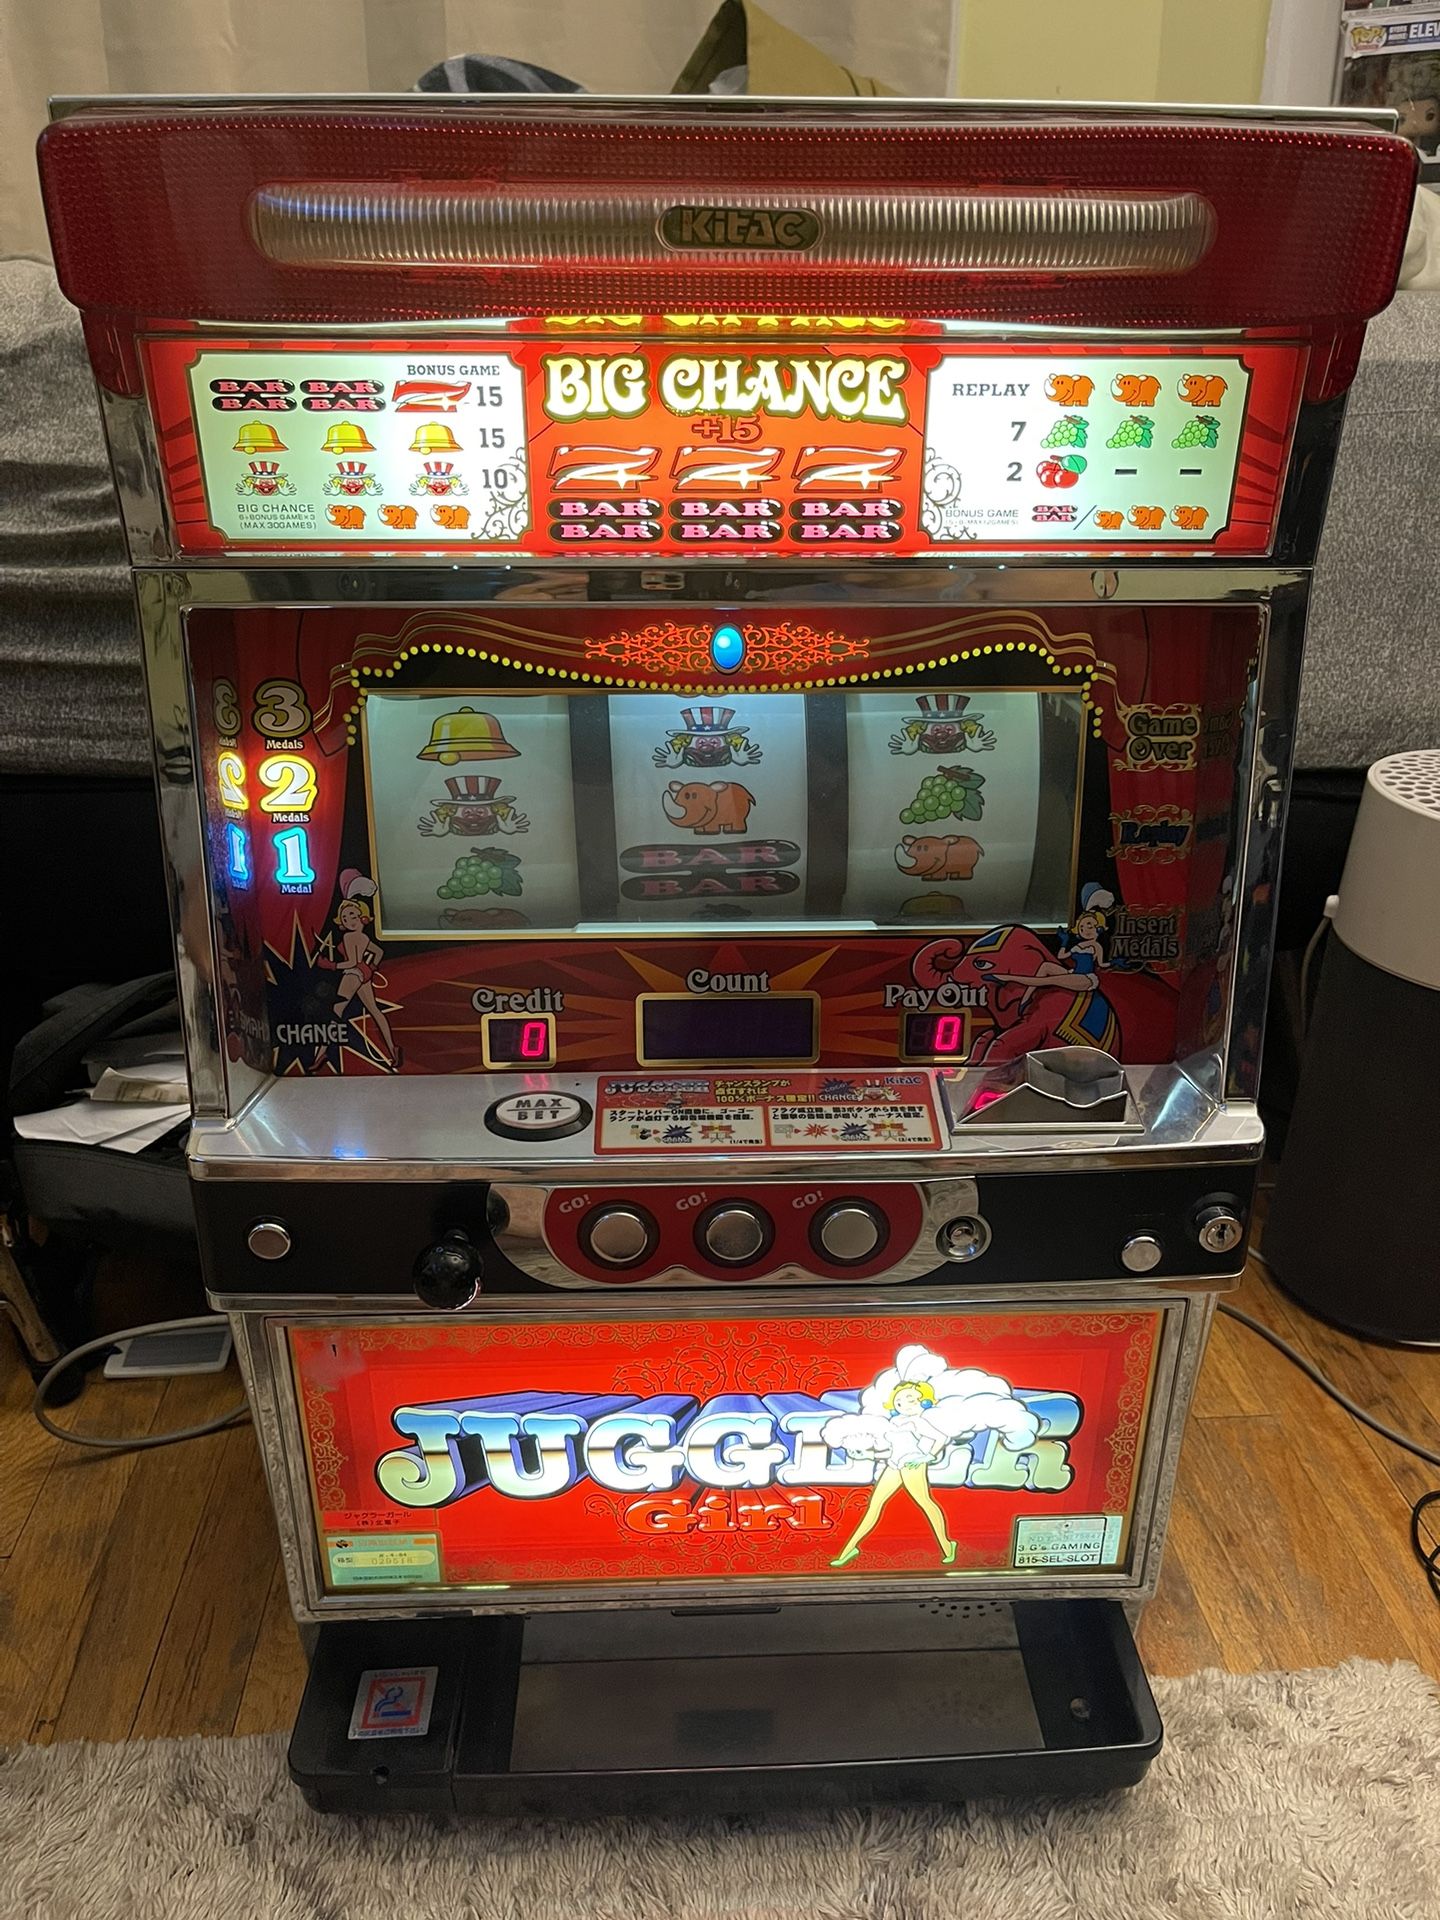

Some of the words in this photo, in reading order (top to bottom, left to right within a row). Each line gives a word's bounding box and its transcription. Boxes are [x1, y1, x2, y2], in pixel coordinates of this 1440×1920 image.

[407, 364, 456, 377] BONUS
[459, 364, 500, 377] GAME
[218, 380, 288, 394] BAR
[307, 380, 377, 394] BAR
[477, 385, 503, 408] 15
[544, 355, 648, 418] BIG
[662, 355, 908, 424] CHANCE
[952, 383, 1031, 397] REPLAY
[218, 397, 289, 411] BAR
[308, 397, 378, 411] BAR
[479, 427, 506, 449] 15
[691, 414, 764, 444] +15
[1010, 421, 1027, 442] 7
[482, 468, 508, 490] 10
[1006, 461, 1023, 482] 2
[237, 503, 259, 513] BIG
[262, 503, 315, 513] CHANCE
[559, 501, 653, 517] BAR
[681, 501, 773, 517] BAR
[801, 501, 893, 517] BAR
[945, 509, 984, 518] BONUS
[987, 509, 1019, 518] GAME
[561, 523, 654, 539] BAR
[681, 523, 773, 539] BAR
[801, 523, 893, 539] BAR
[254, 680, 312, 736] 3
[1127, 712, 1199, 737] Game
[266, 739, 304, 750] Medals
[1128, 737, 1194, 761] Over
[258, 754, 318, 812] 2
[272, 812, 310, 823] Medals
[272, 826, 316, 884] 1
[641, 846, 780, 868] BAR
[281, 884, 312, 894] Medal
[641, 876, 780, 897] BAR
[1116, 914, 1176, 935] Insert
[1111, 937, 1178, 959] Medals
[686, 968, 770, 993] Count
[472, 987, 564, 1014] Credit
[276, 1022, 349, 1046] CHANCE
[522, 1022, 547, 1057] 0
[935, 1016, 961, 1051] 0
[516, 1098, 562, 1108] MAX
[517, 1110, 560, 1121] BET
[558, 1193, 592, 1214] GO!
[675, 1191, 708, 1211] GO!
[791, 1189, 824, 1210] GO!
[374, 1389, 1083, 1509] JUGGLR
[623, 1495, 834, 1534] Girl
[1029, 1543, 1047, 1552] G's
[1051, 1542, 1101, 1551] GAMING
